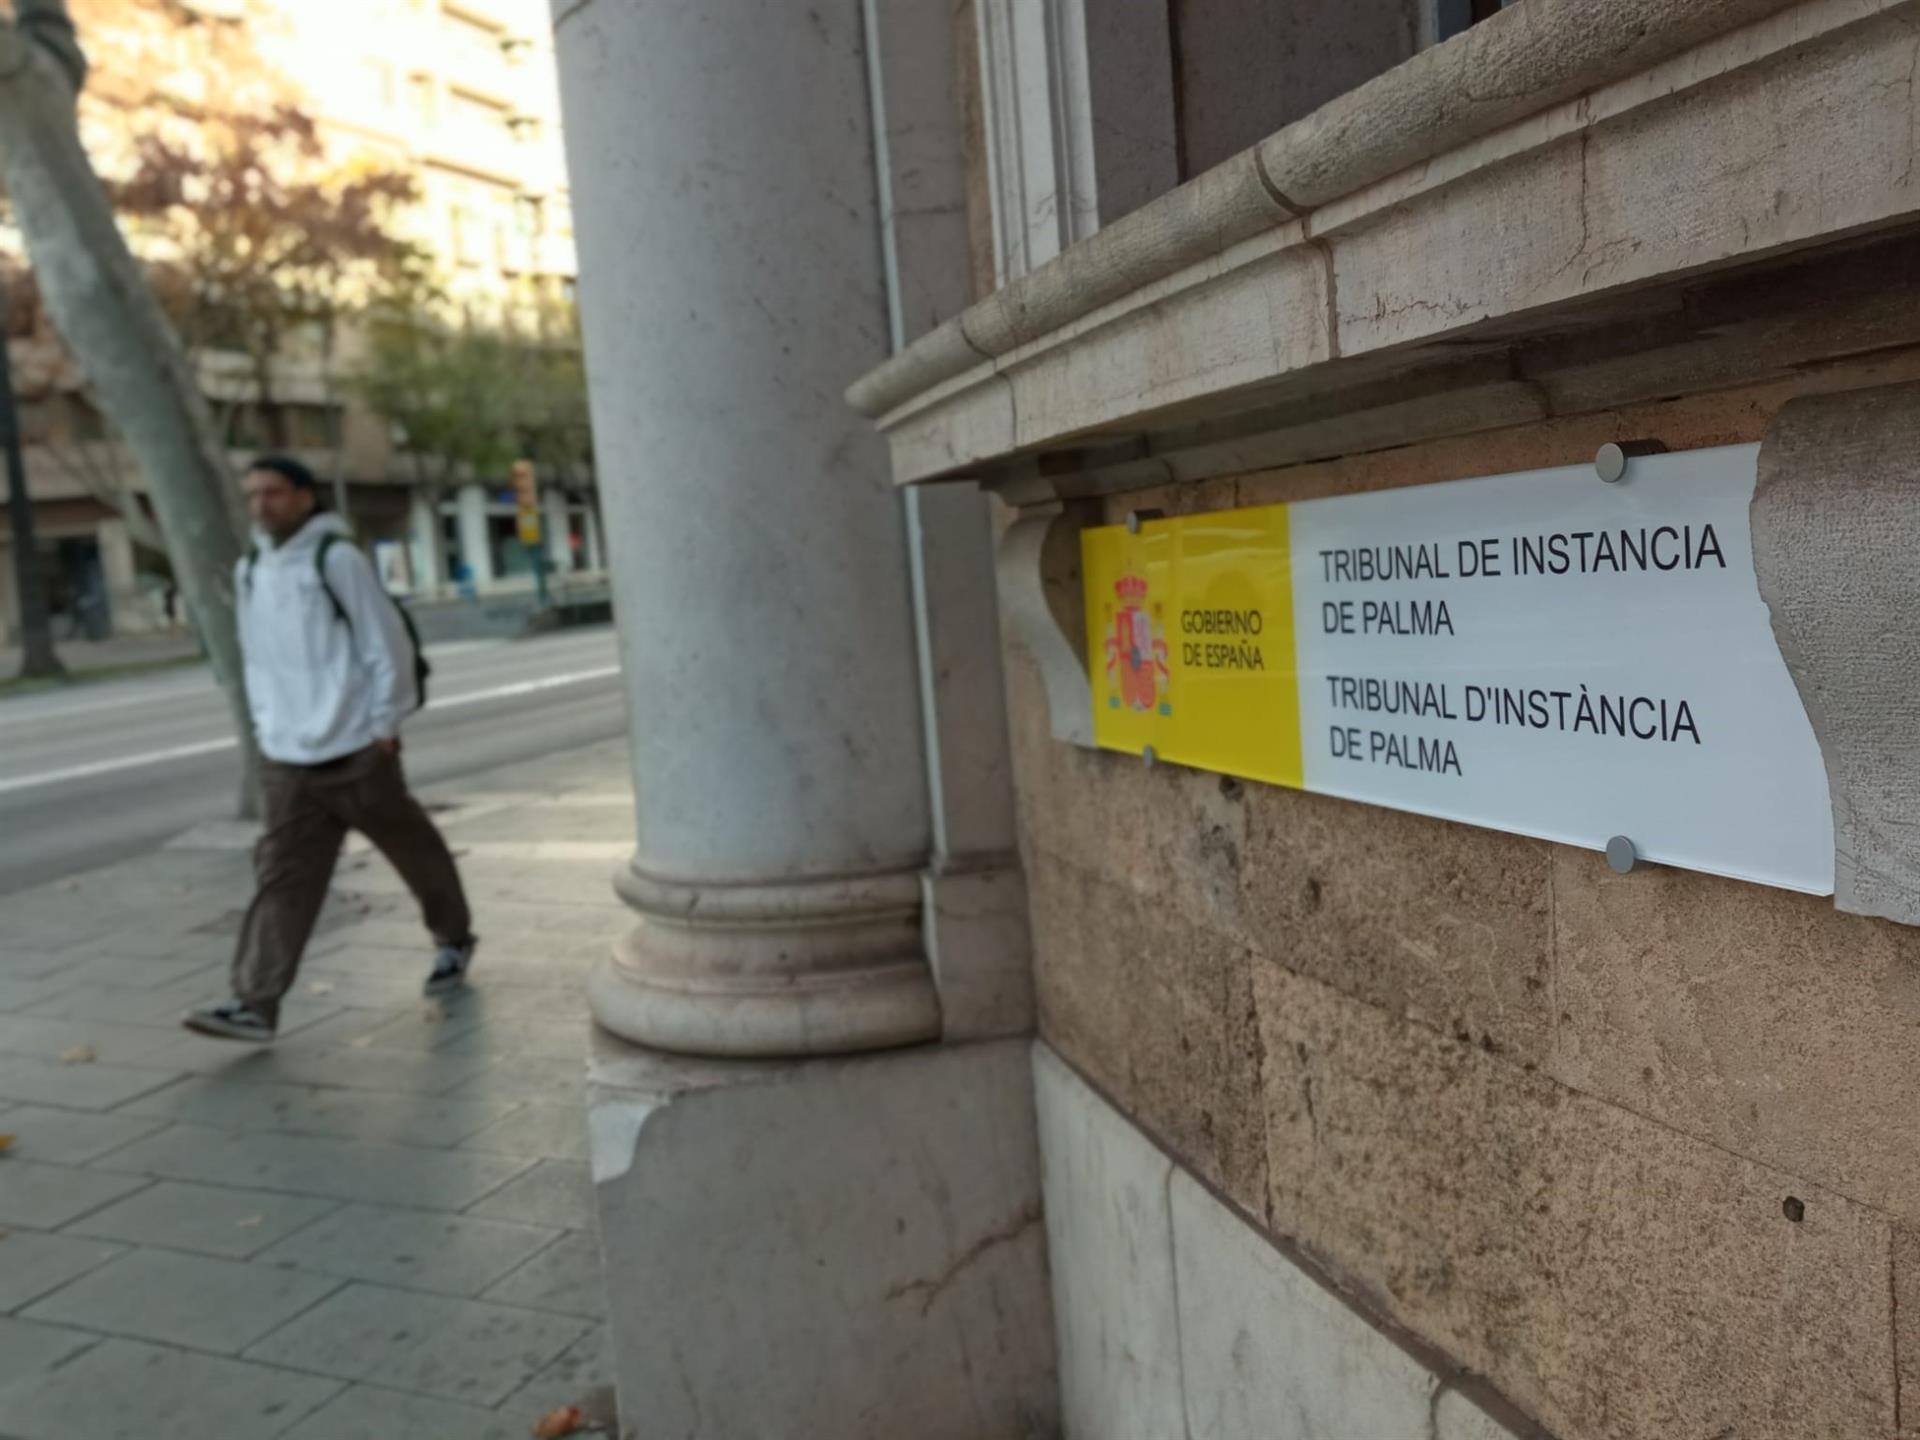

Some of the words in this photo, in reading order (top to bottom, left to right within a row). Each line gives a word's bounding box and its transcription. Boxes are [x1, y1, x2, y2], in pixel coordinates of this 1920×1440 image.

[1319, 543, 1450, 582] TRIBUNAL
[1458, 539, 1502, 578] DE
[1512, 523, 1727, 576] INSTANCIA
[1181, 610, 1263, 635] GOBIERNO
[1322, 601, 1356, 635] DE
[1363, 600, 1455, 636] PALMA
[1183, 642, 1203, 667] DE
[1205, 640, 1265, 671] ESPAÑA
[1326, 676, 1458, 720] TRIBUNAL
[1465, 684, 1701, 745] D'INSTÀNCIA
[1330, 726, 1364, 761] DE
[1370, 731, 1463, 777] PALMA
